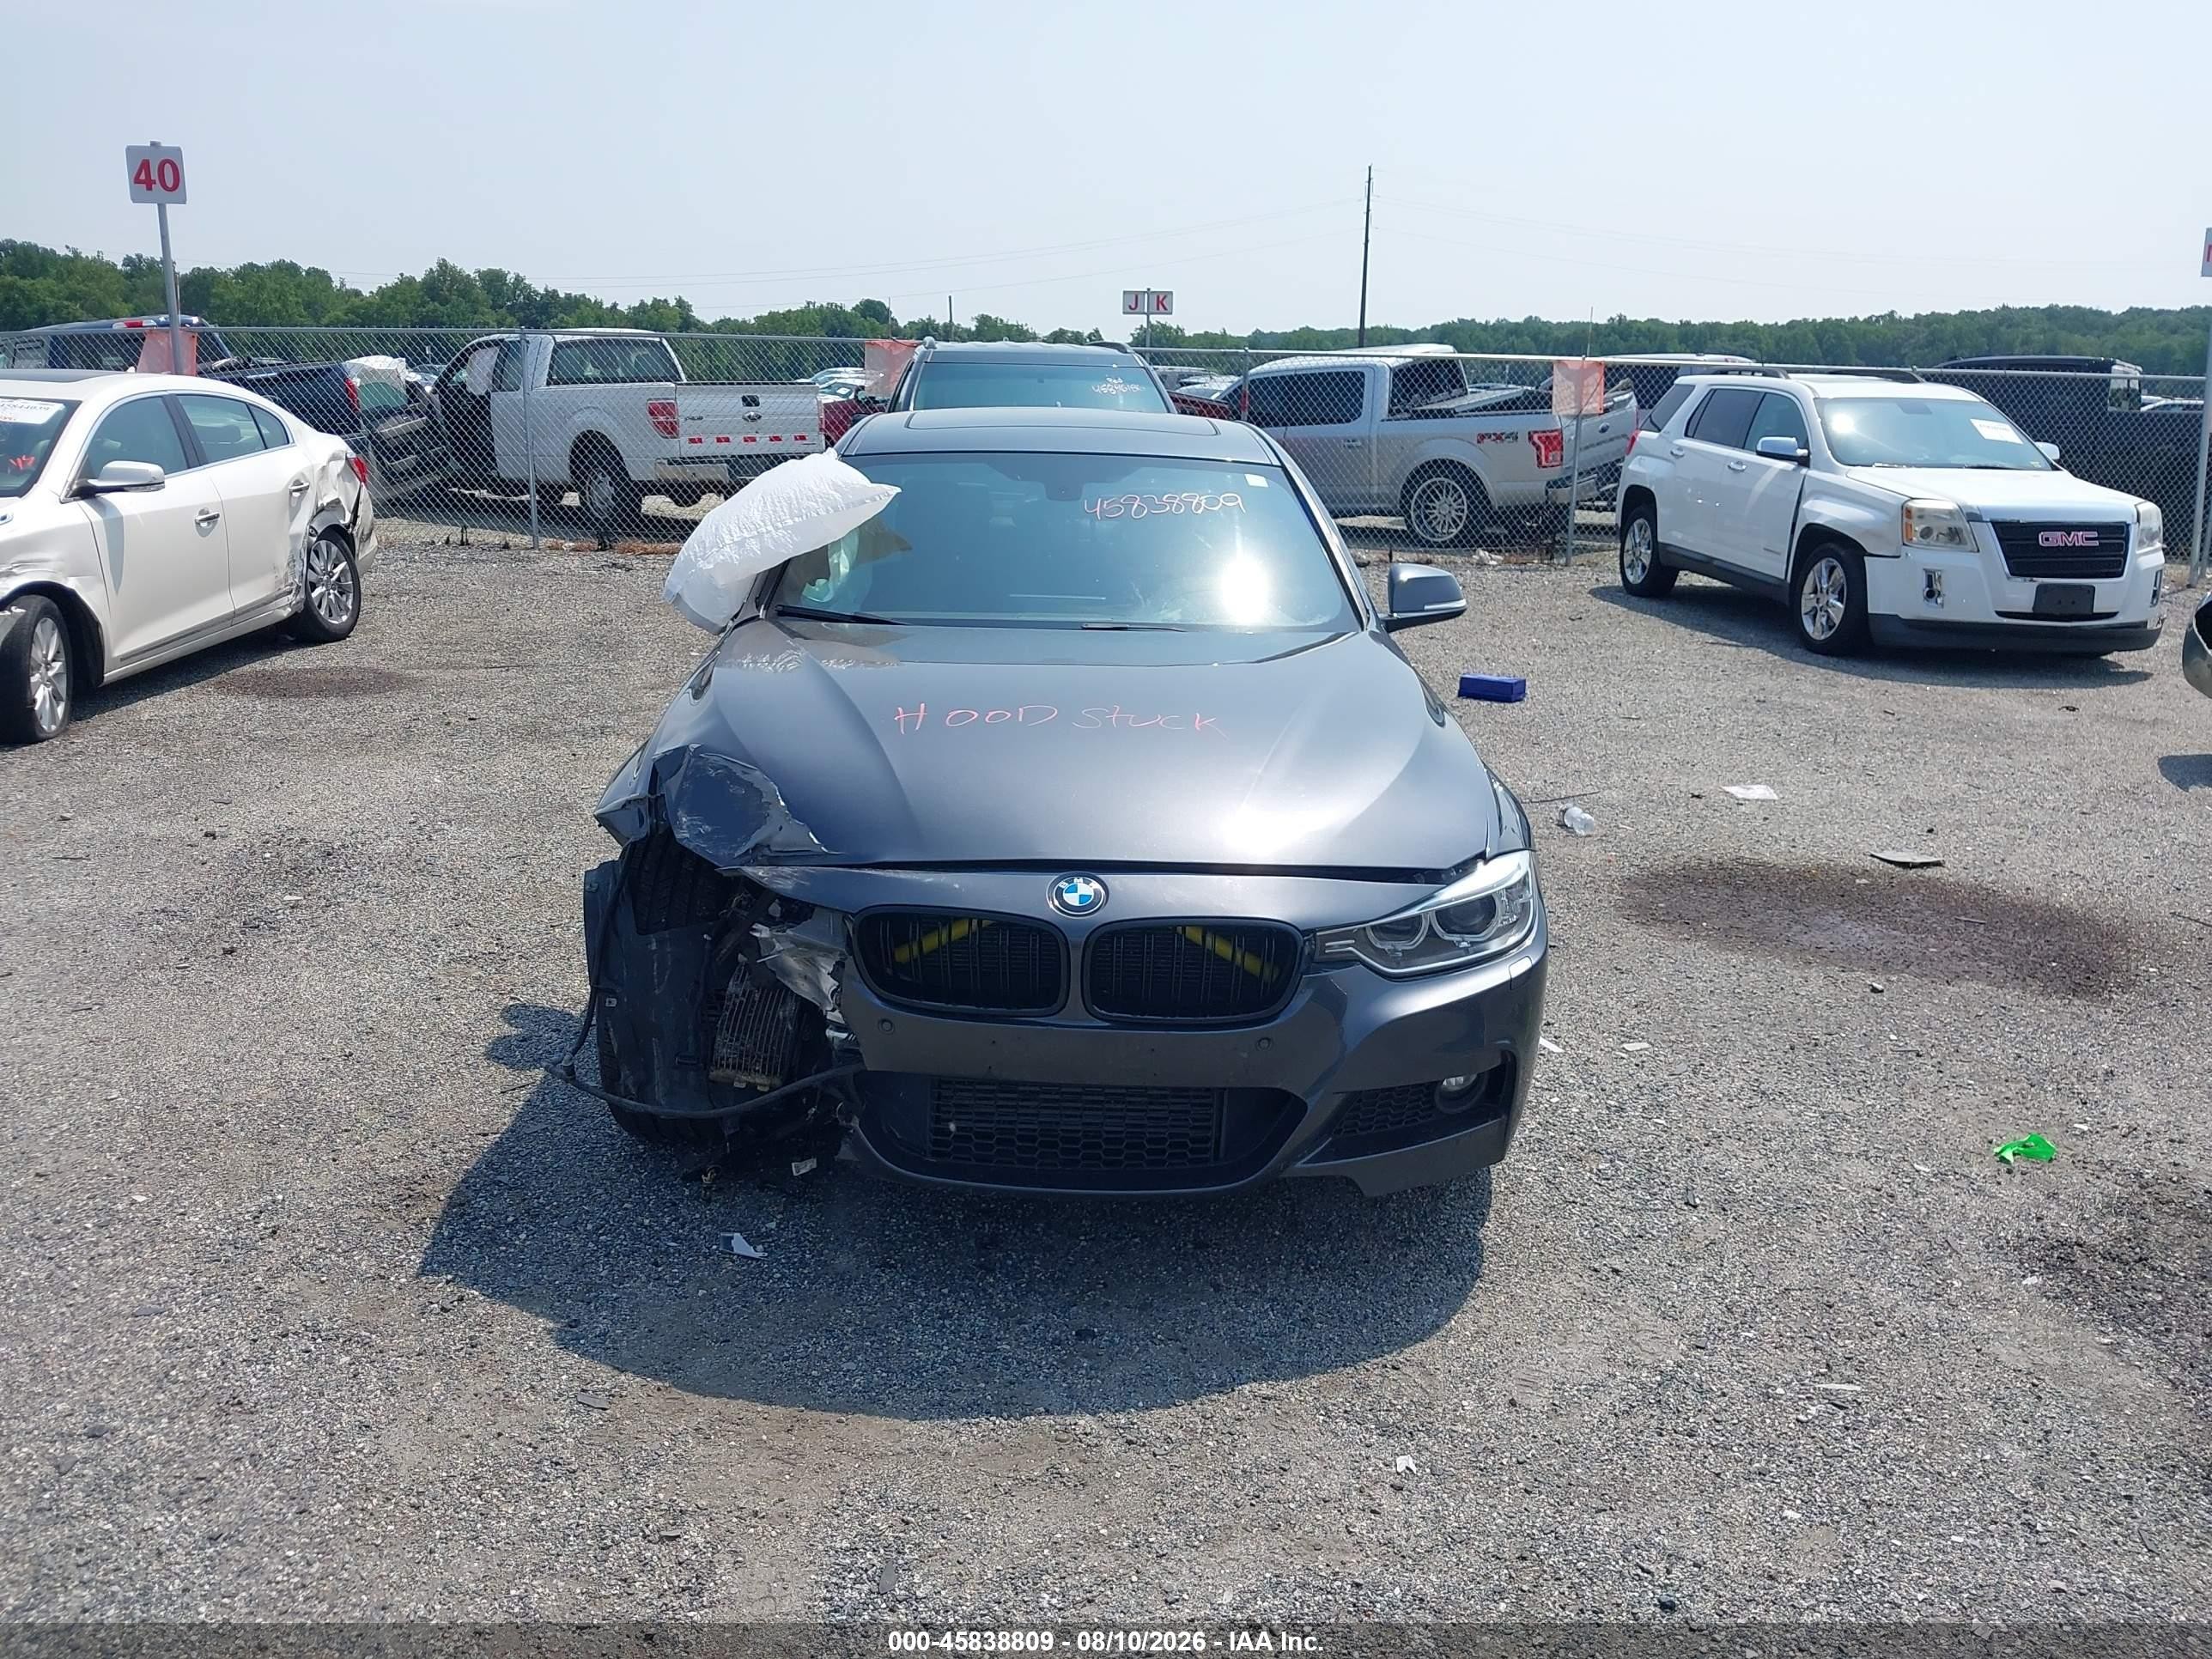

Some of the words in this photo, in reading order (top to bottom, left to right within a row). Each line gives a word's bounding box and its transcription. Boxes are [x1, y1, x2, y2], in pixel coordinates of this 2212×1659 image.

[133, 158, 180, 192] 40
[1128, 294, 1139, 311] J
[1156, 295, 1168, 311] K
[1084, 493, 1246, 521] 45838809
[2039, 531, 2100, 547] GMC
